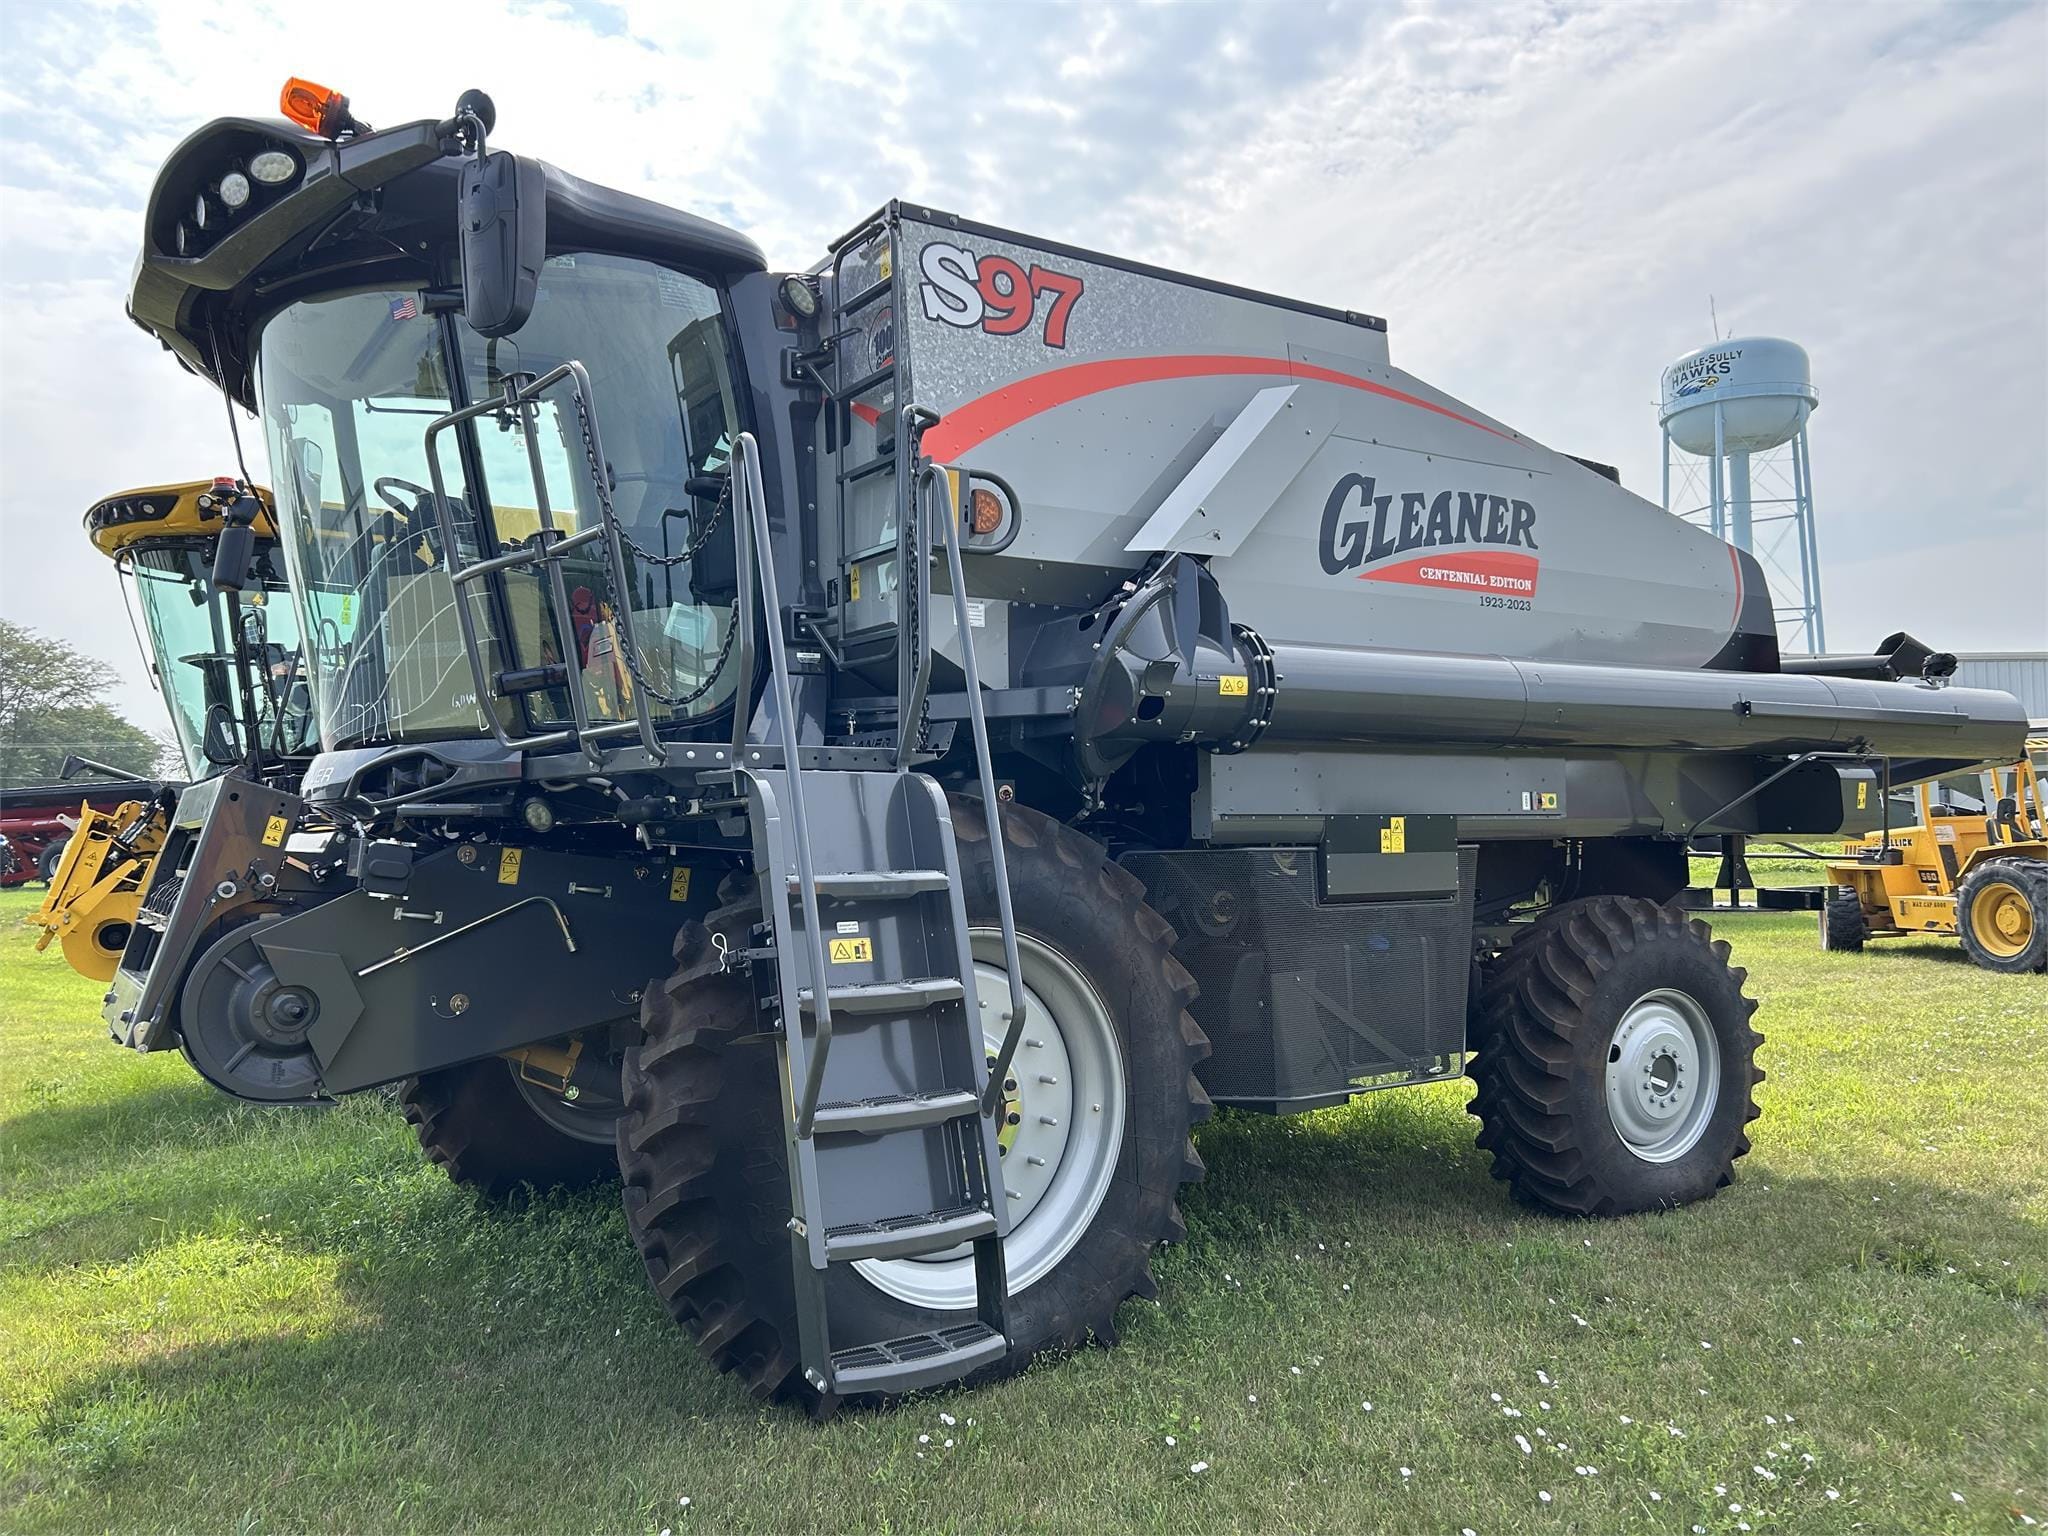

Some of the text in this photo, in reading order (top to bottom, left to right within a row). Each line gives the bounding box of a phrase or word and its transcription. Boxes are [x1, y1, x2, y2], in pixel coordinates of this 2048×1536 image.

[919, 241, 1085, 350] S97
[1671, 361, 1731, 390] HAWKS
[1318, 472, 1539, 576] GLEANER
[1419, 567, 1532, 591] CENTENNIAL EDITION
[1479, 595, 1532, 612] 1923-2023
